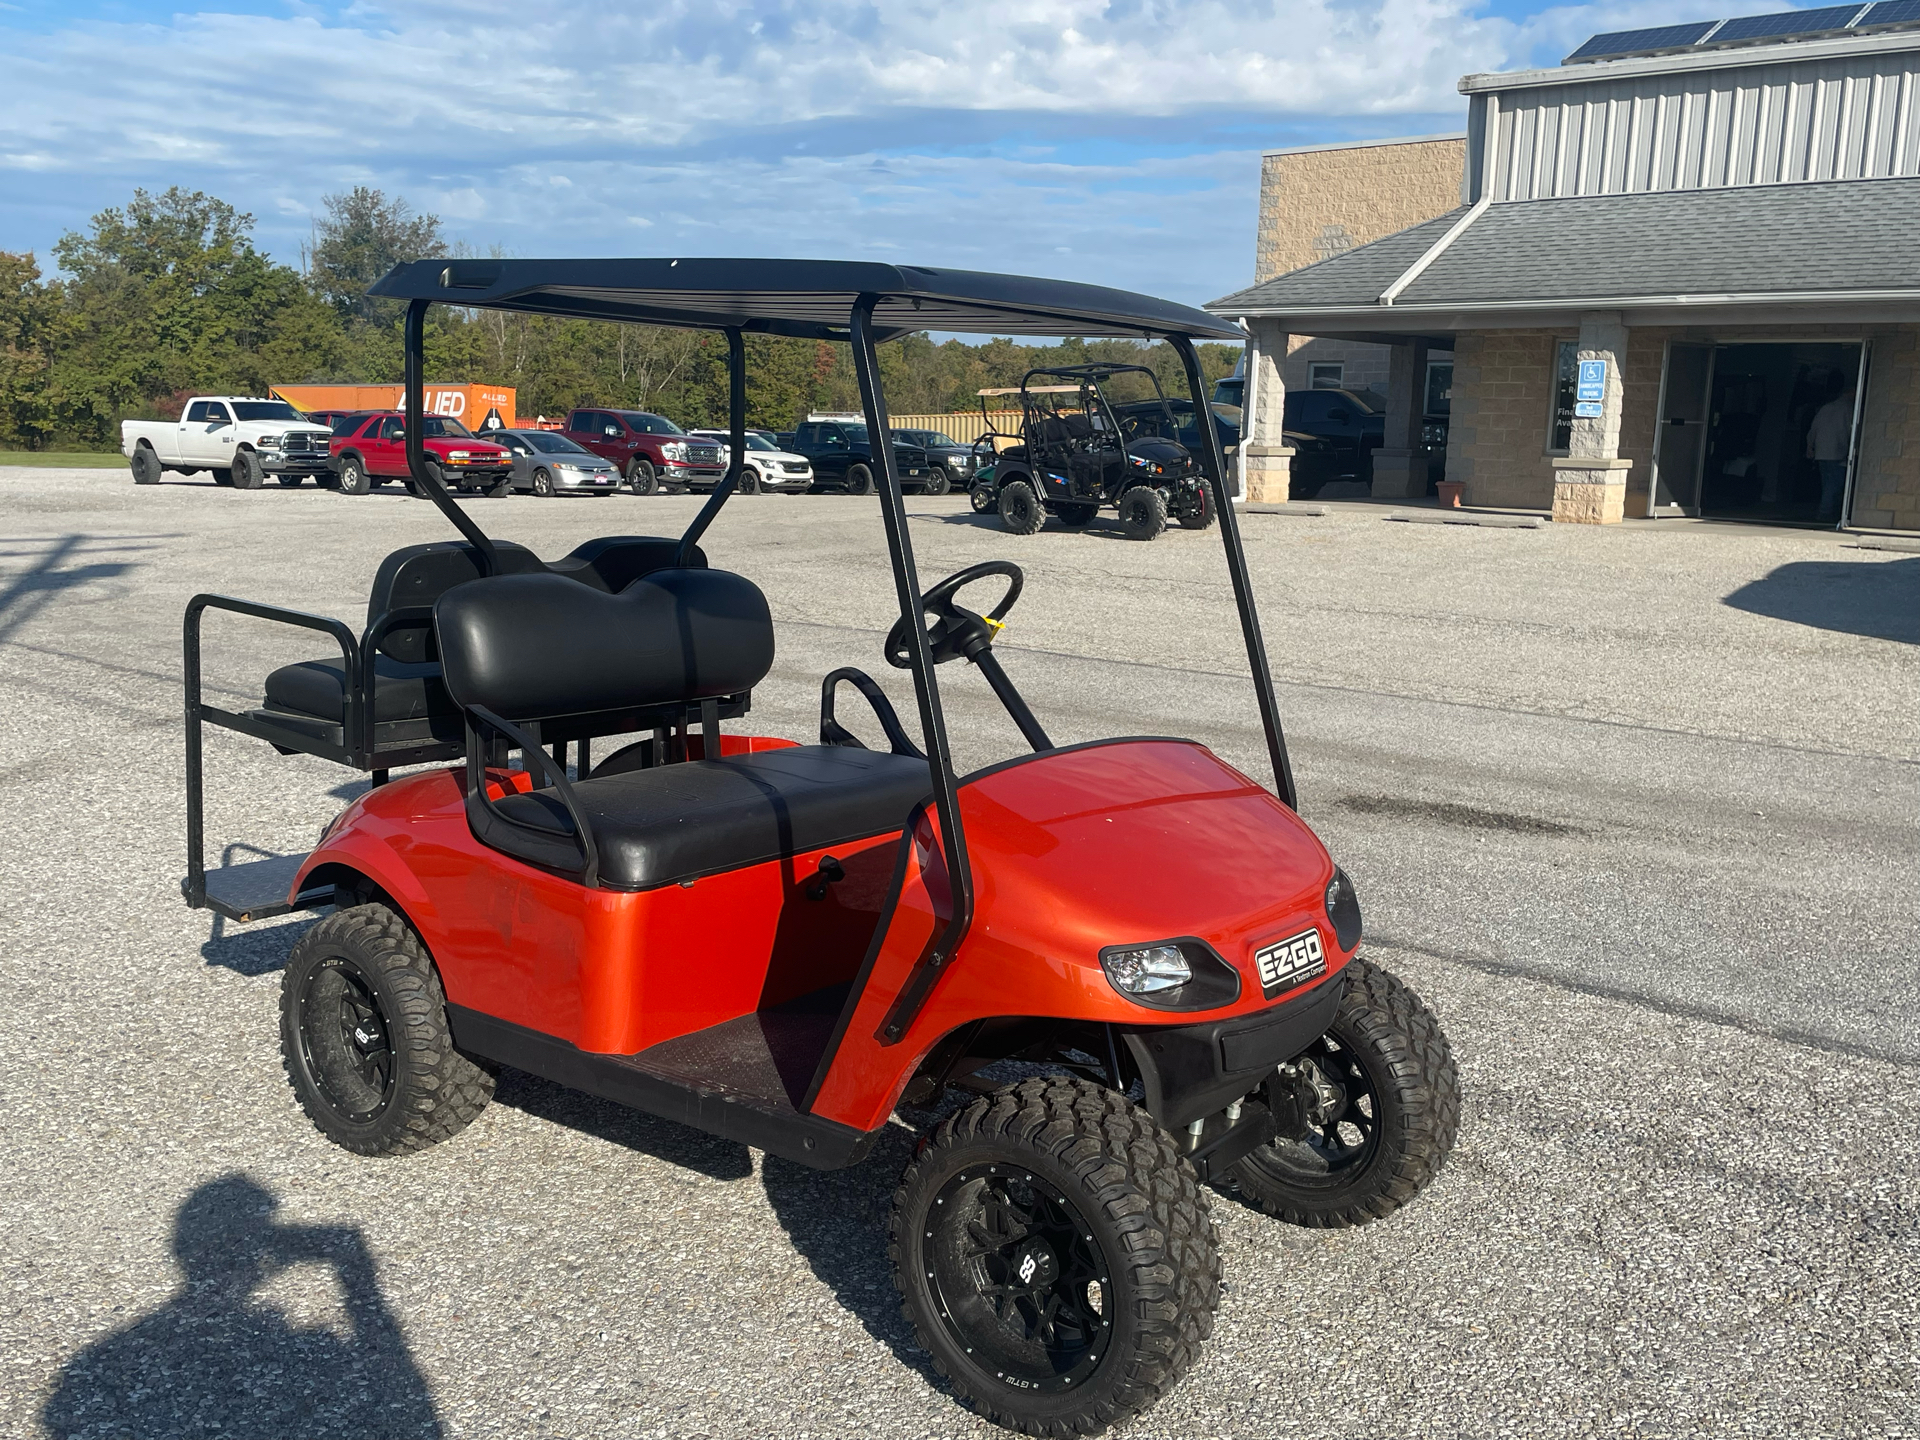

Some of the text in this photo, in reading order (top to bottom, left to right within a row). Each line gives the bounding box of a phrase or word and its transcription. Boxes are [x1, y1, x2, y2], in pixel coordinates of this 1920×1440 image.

[396, 391, 466, 417] ALIED
[481, 392, 507, 402] ALLIED
[1005, 1375, 1030, 1389] GTW
